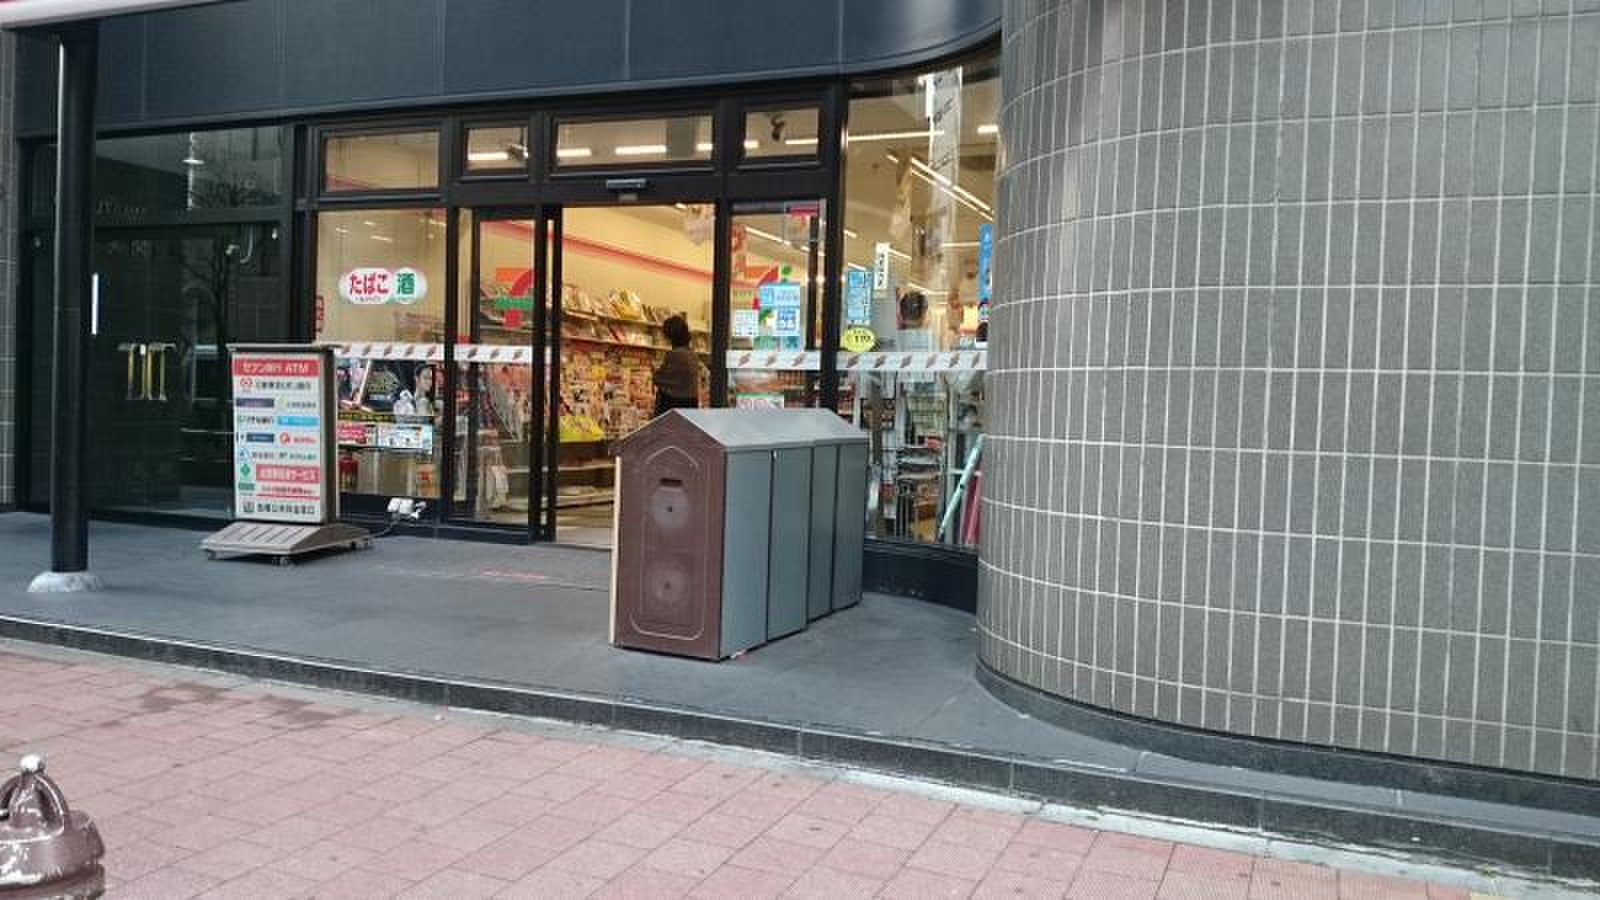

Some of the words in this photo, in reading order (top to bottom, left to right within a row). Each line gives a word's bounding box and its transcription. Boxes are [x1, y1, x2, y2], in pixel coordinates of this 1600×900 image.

[350, 272, 389, 295] たばこ
[397, 272, 415, 295] 酒
[285, 361, 310, 375] ATM
